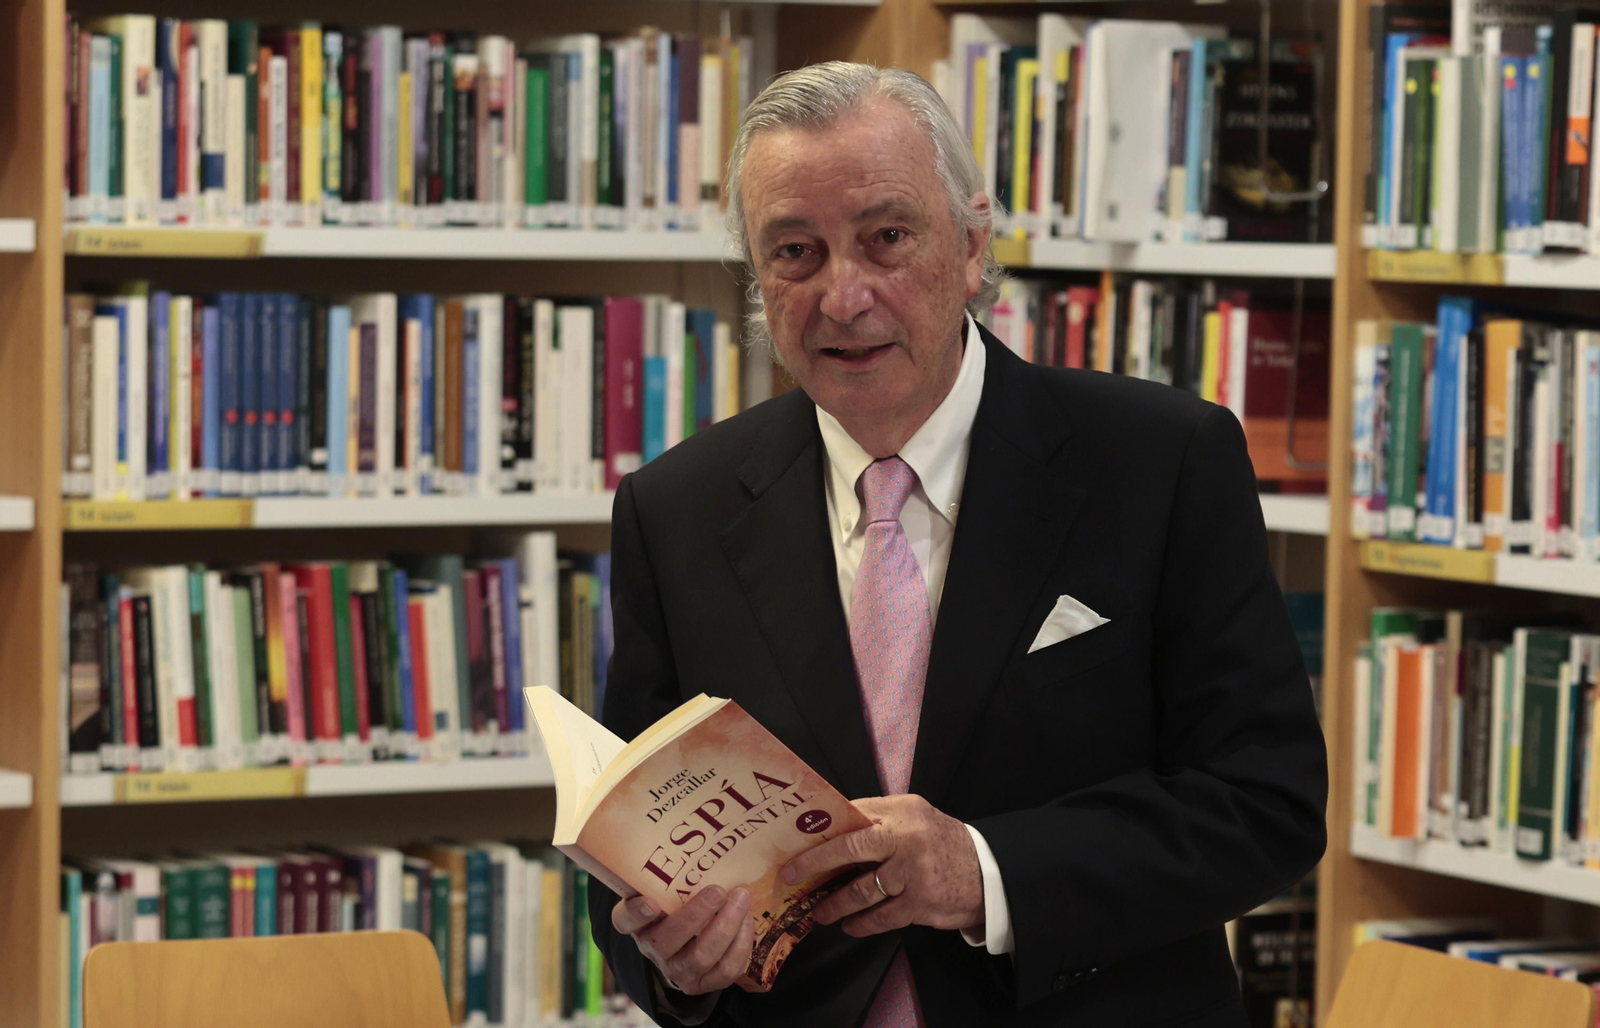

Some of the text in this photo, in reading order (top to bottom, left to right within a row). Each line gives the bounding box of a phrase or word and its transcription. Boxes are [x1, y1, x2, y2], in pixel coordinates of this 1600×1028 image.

[646, 767, 718, 824] Dezcallar
[648, 768, 692, 803] Jorge
[641, 771, 797, 891] ESPÍA
[675, 791, 813, 904] ACCIDENTAL
[806, 817, 829, 832] edición
